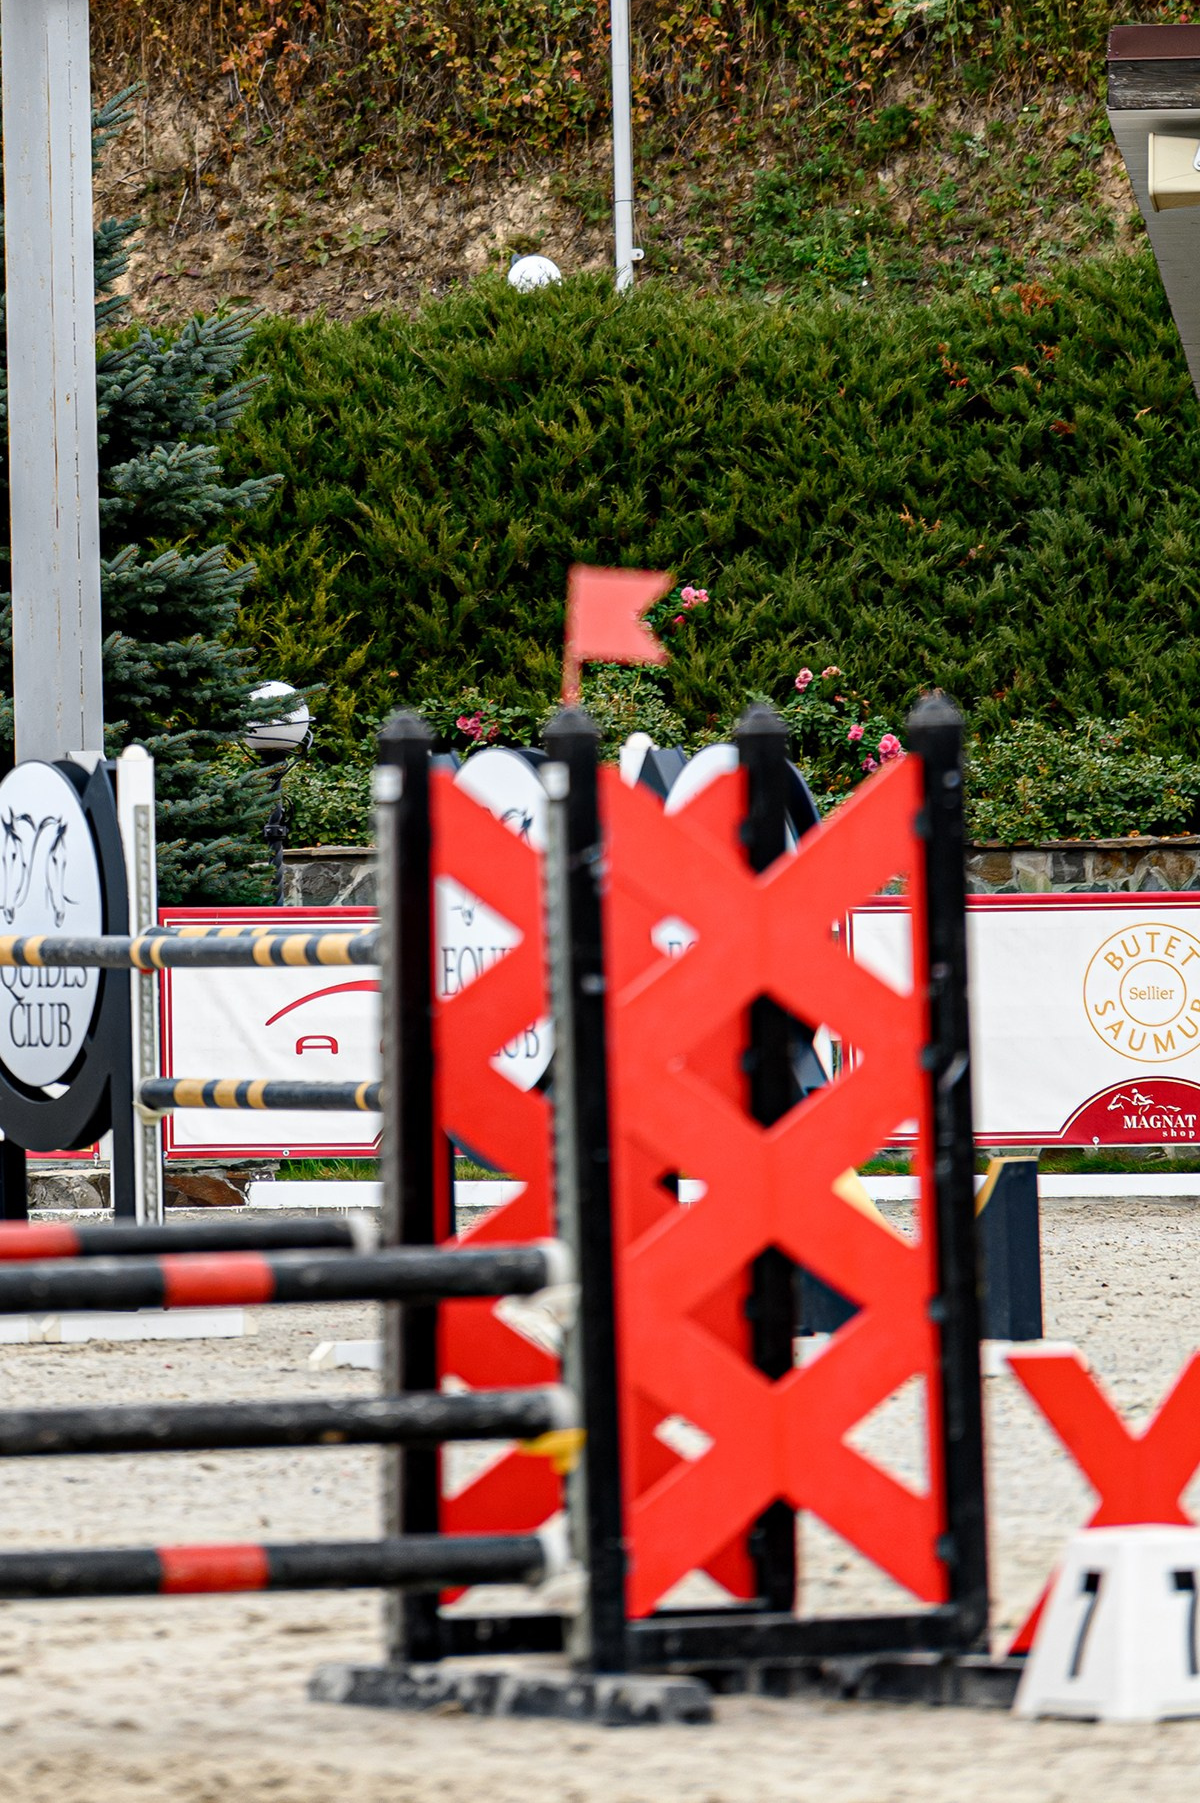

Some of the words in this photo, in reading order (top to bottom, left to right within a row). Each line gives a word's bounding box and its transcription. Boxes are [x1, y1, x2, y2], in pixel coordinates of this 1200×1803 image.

[1129, 986, 1175, 1001] Sellier
[9, 1002, 72, 1048] CLUB
[1122, 1114, 1197, 1129] MAGNAT
[1162, 1129, 1196, 1138] shop
